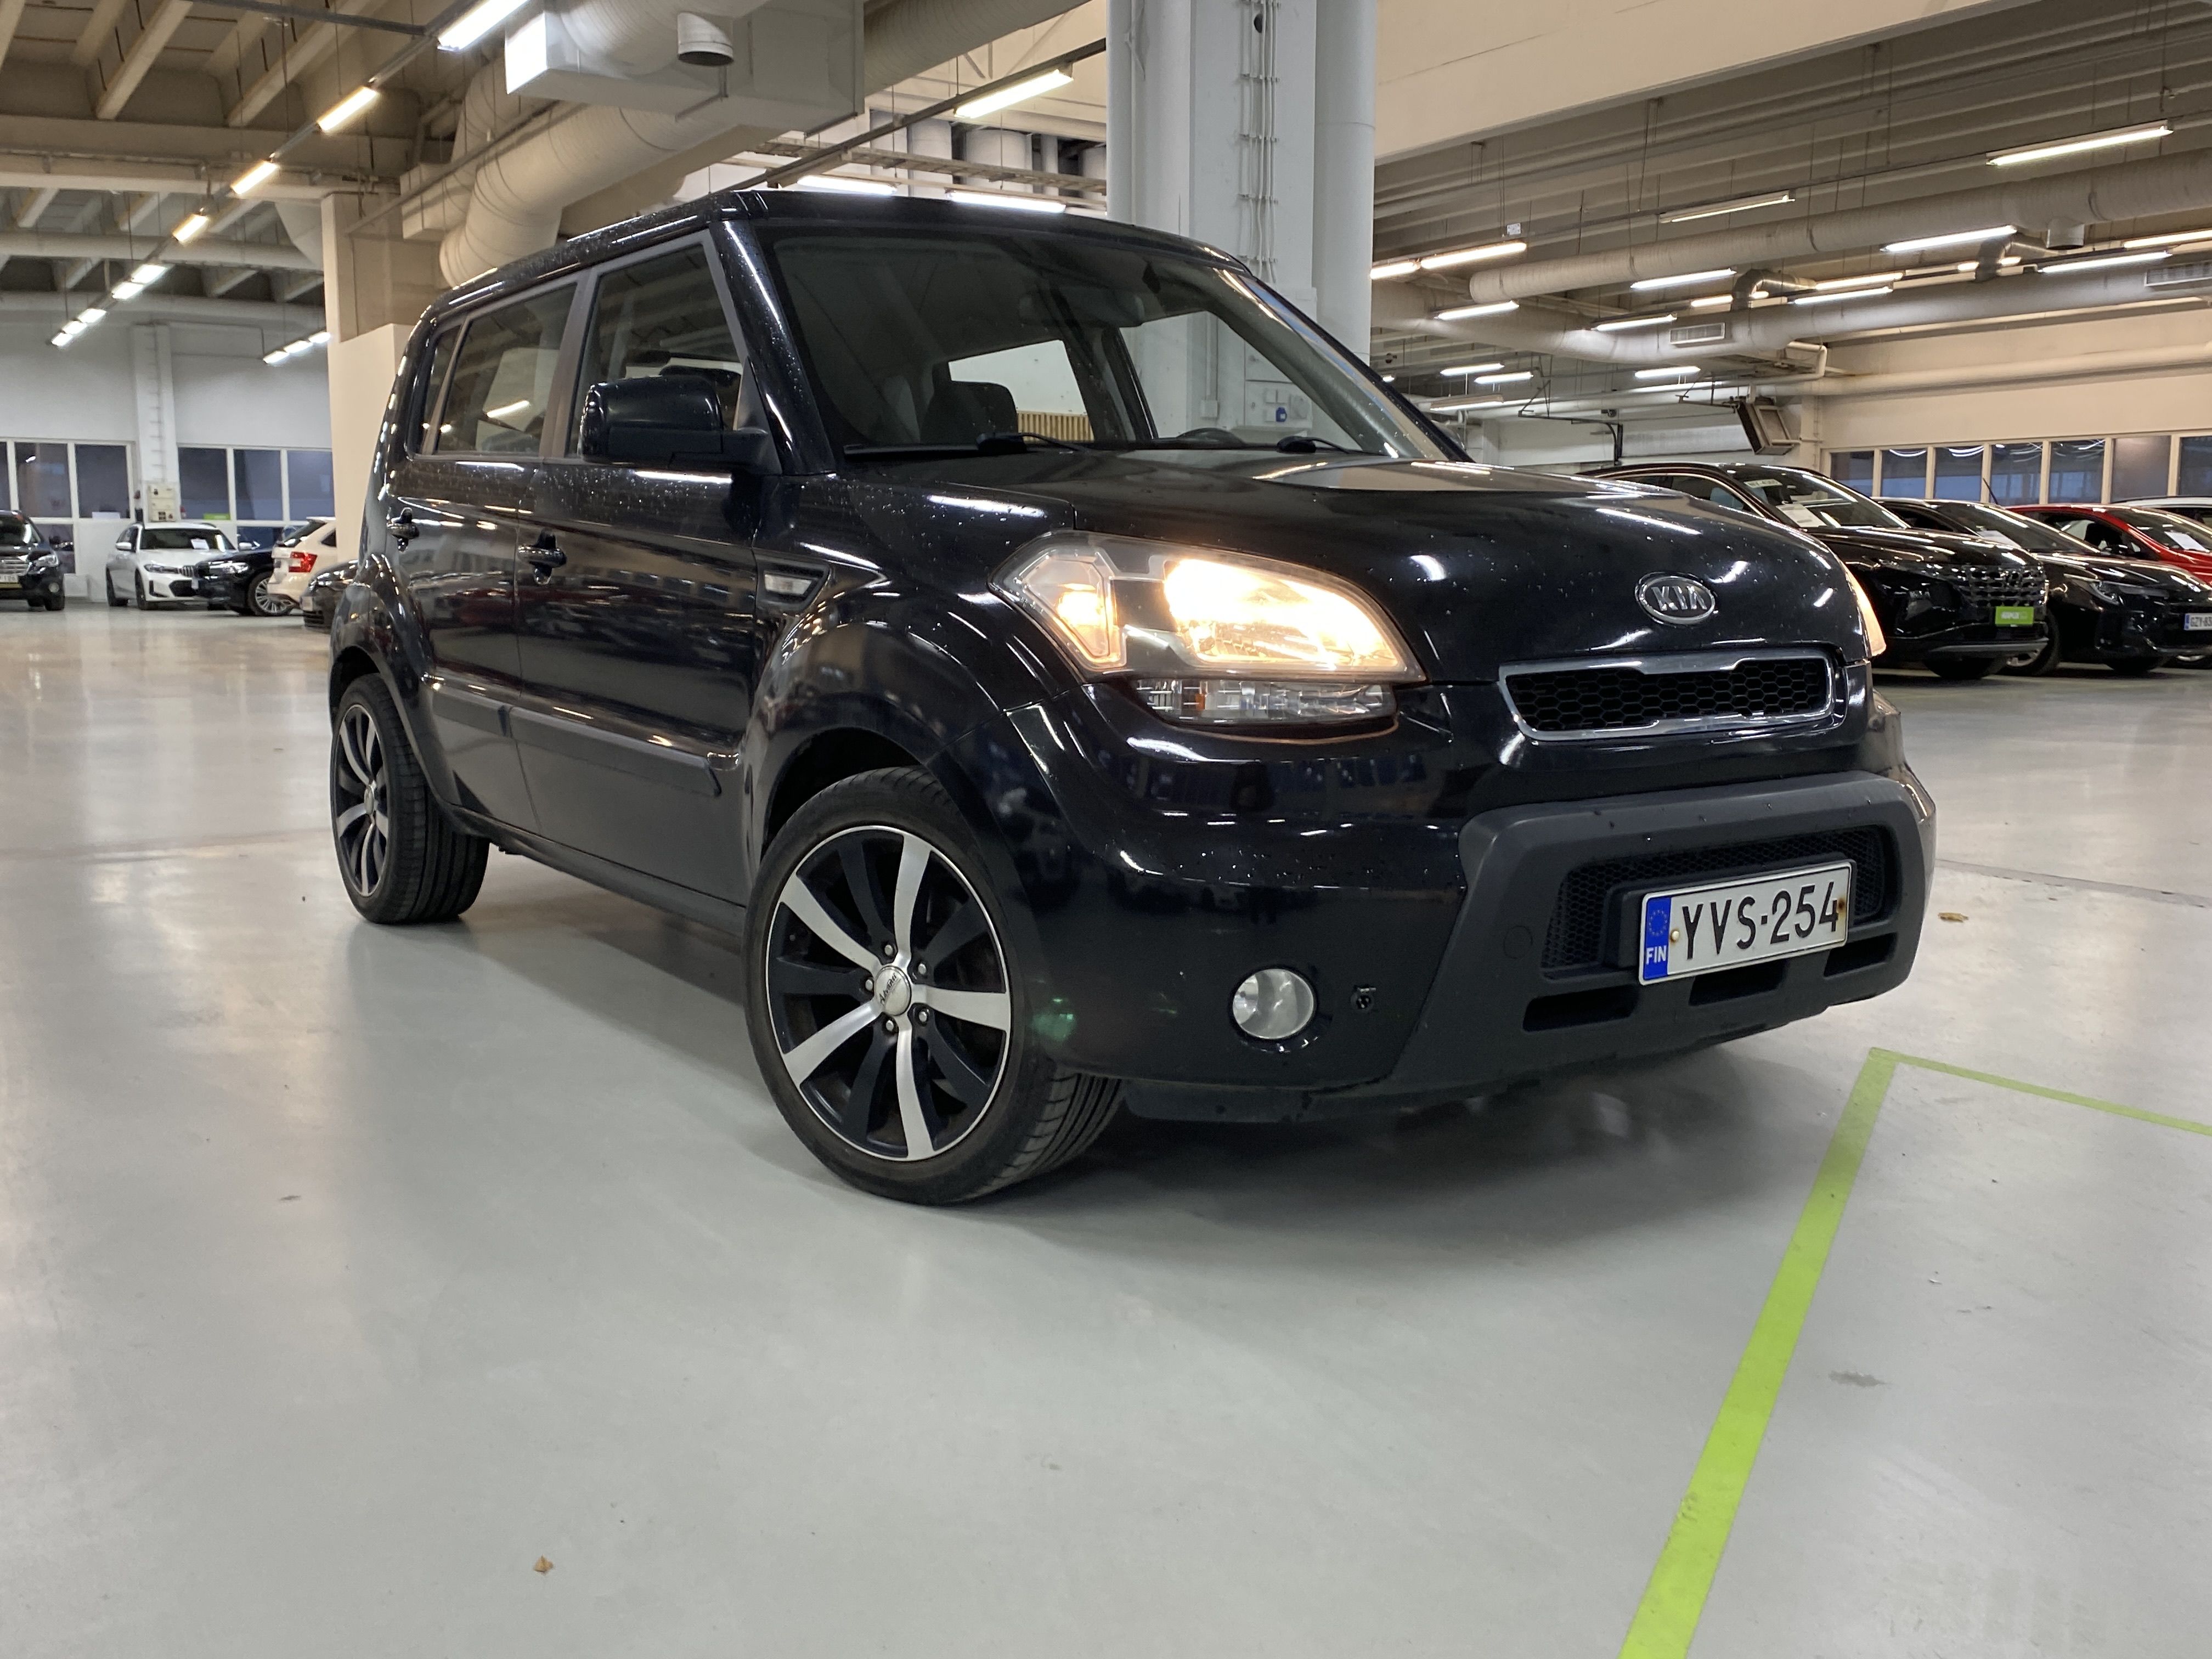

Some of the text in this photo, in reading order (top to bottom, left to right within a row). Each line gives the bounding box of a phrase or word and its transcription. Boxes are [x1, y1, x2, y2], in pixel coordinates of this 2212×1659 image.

[1651, 585, 1707, 611] KIA
[1682, 881, 1839, 960] YVS-254
[1646, 945, 1667, 965] FIN
